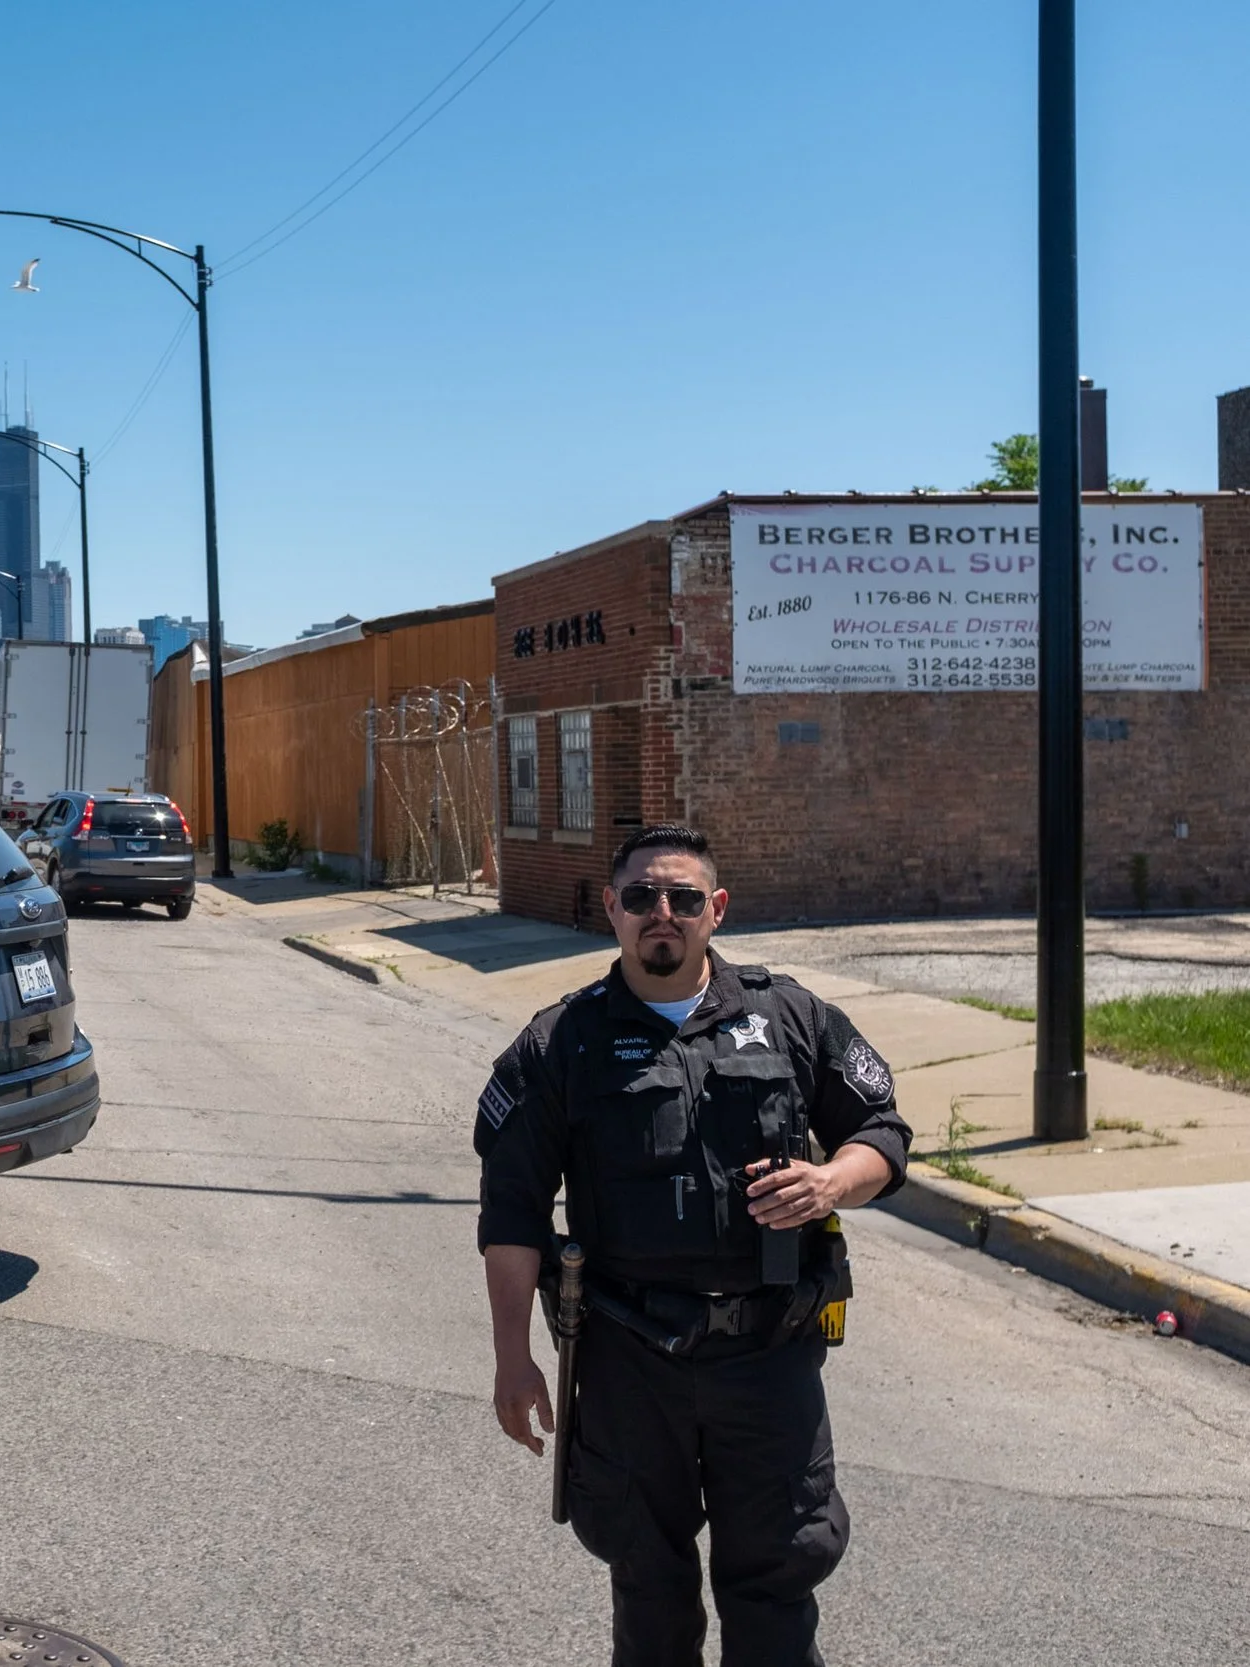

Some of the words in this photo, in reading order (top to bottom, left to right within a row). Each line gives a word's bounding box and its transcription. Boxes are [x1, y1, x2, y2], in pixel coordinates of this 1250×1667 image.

[758, 523, 893, 545] BERGER
[908, 523, 1096, 548] BROTHE,
[1112, 523, 1180, 545] INC.
[769, 553, 956, 574] CHARCOAL
[969, 552, 1097, 574] SUPY
[1111, 552, 1169, 573] CO.
[854, 590, 931, 605] 1176-86
[937, 590, 958, 605] N.
[965, 589, 1040, 605] CHERRY
[747, 604, 773, 622] Est.
[777, 594, 812, 617] 1880
[833, 618, 958, 635] WHOLESALE
[965, 617, 1112, 634] DISTRION
[831, 638, 869, 650] OPEN
[874, 638, 894, 650] TO
[899, 638, 925, 650] THE
[930, 638, 980, 650] PUBLIC
[747, 664, 796, 674] NATURAL
[800, 664, 831, 673] LUMP
[834, 663, 892, 673] CHARCOAL
[907, 656, 1036, 671] 312-642-4238
[1107, 663, 1138, 672] LUMP
[1140, 662, 1197, 672] CHARCOAL
[743, 675, 773, 686] PURE
[776, 675, 839, 685] HARDWOOD
[842, 675, 896, 685] BRIQUETS
[907, 673, 1036, 687] 312-642-5538
